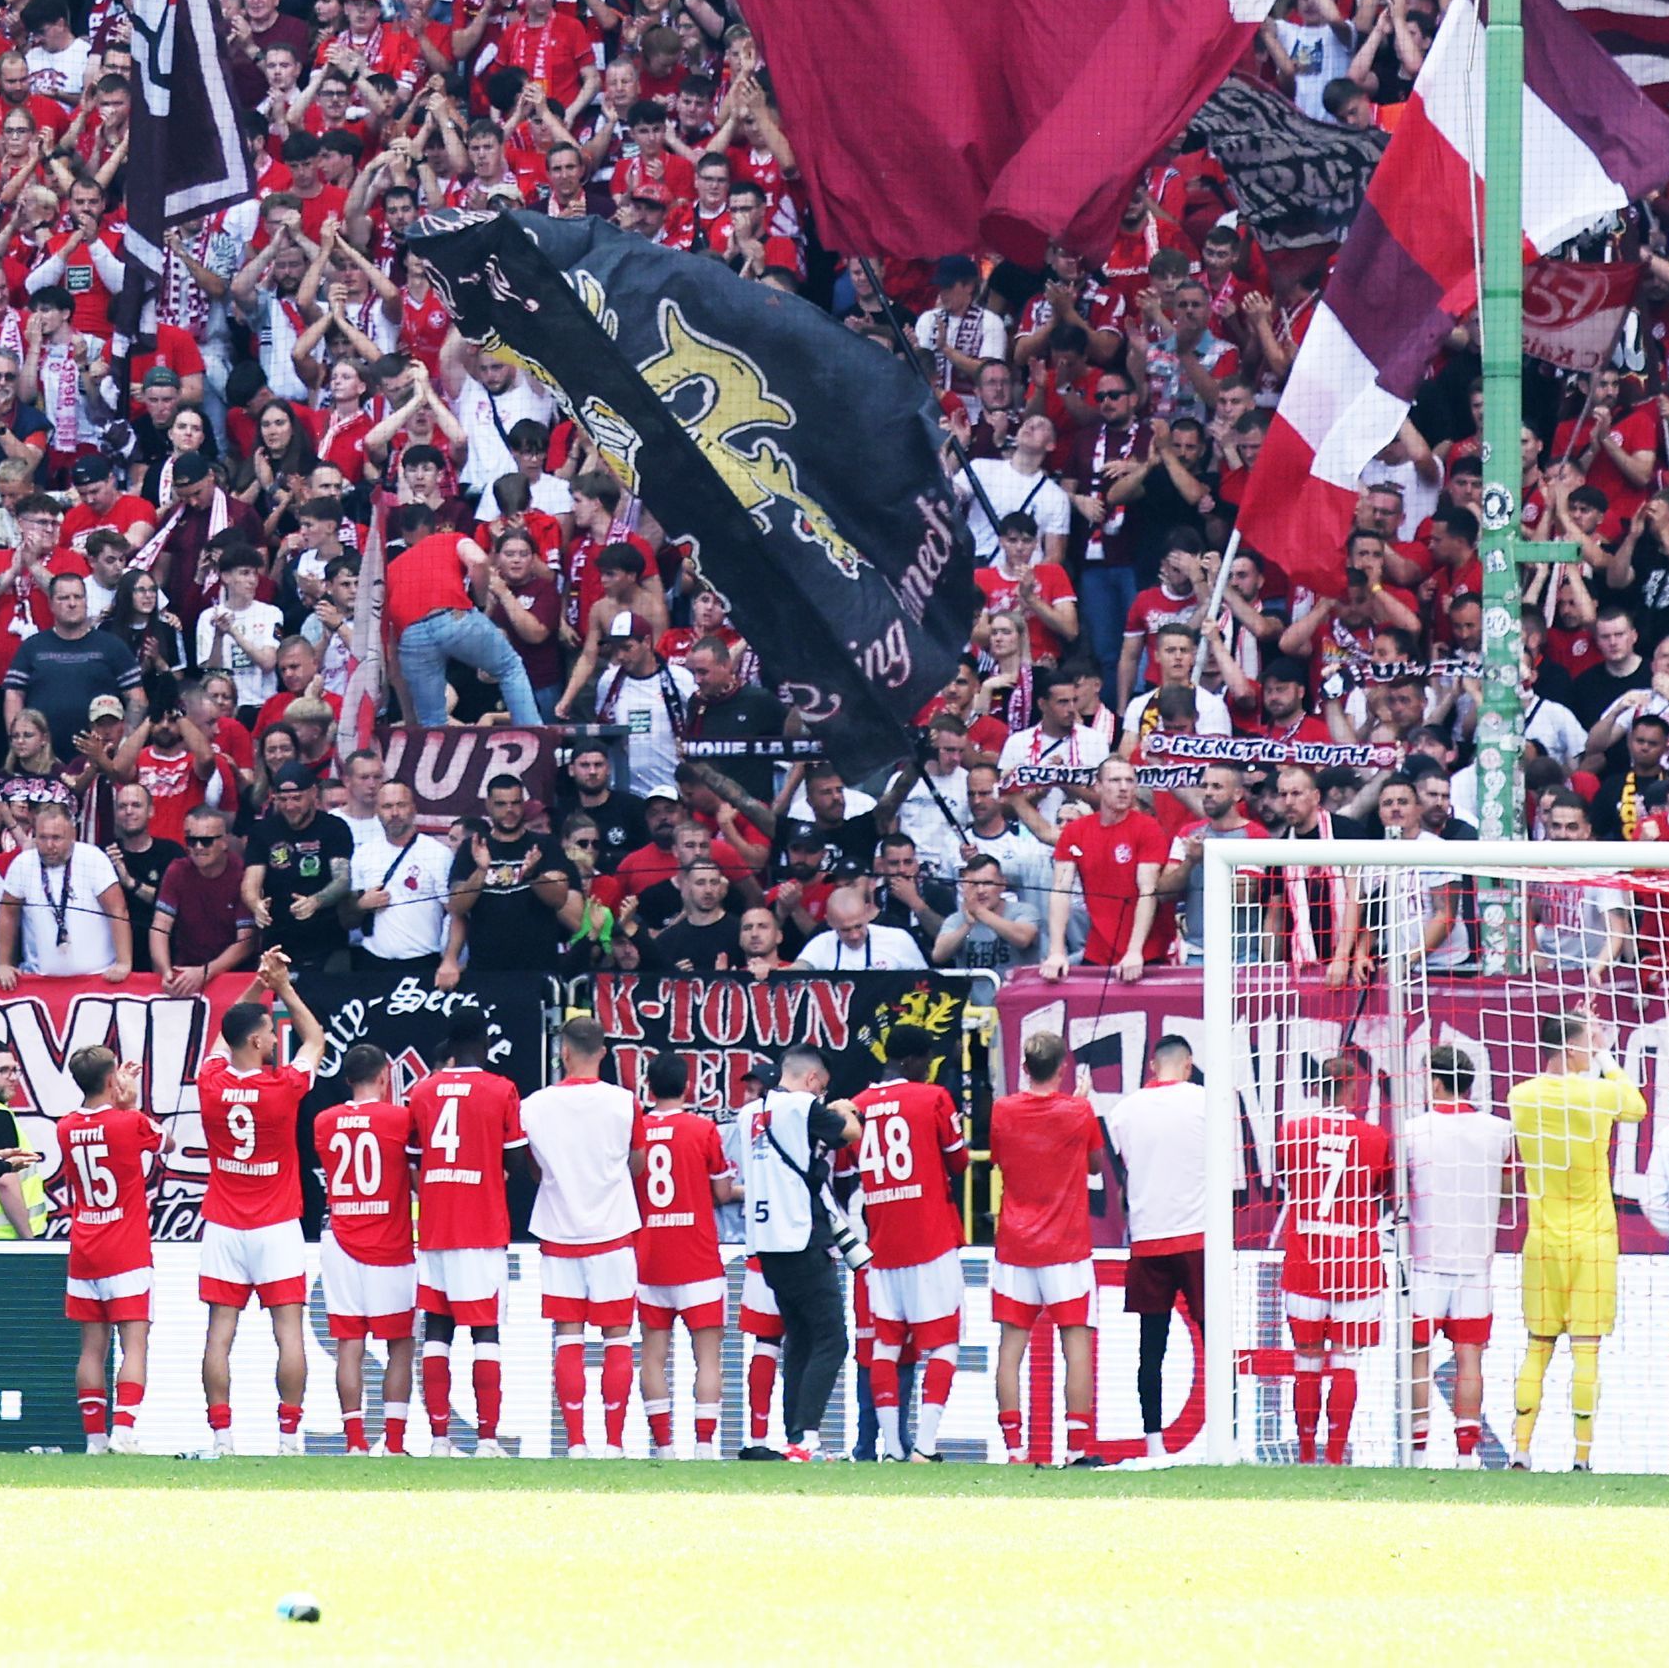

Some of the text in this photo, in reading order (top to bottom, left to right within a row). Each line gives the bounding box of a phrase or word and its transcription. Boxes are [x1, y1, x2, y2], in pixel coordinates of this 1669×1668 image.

[753, 741, 784, 756] LA
[1016, 765, 1098, 788] FRENET
[1170, 733, 1374, 766] FRENETIC YOUTH
[594, 973, 855, 1050] K-TOWN
[614, 1043, 772, 1115] RED
[226, 1103, 256, 1161] 9
[430, 1097, 460, 1164] 4
[857, 1116, 913, 1185] 48
[70, 1144, 118, 1208] 15
[328, 1131, 383, 1197] 20
[646, 1144, 676, 1209] 8
[1316, 1149, 1348, 1217] 7
[754, 1200, 770, 1223] 5
